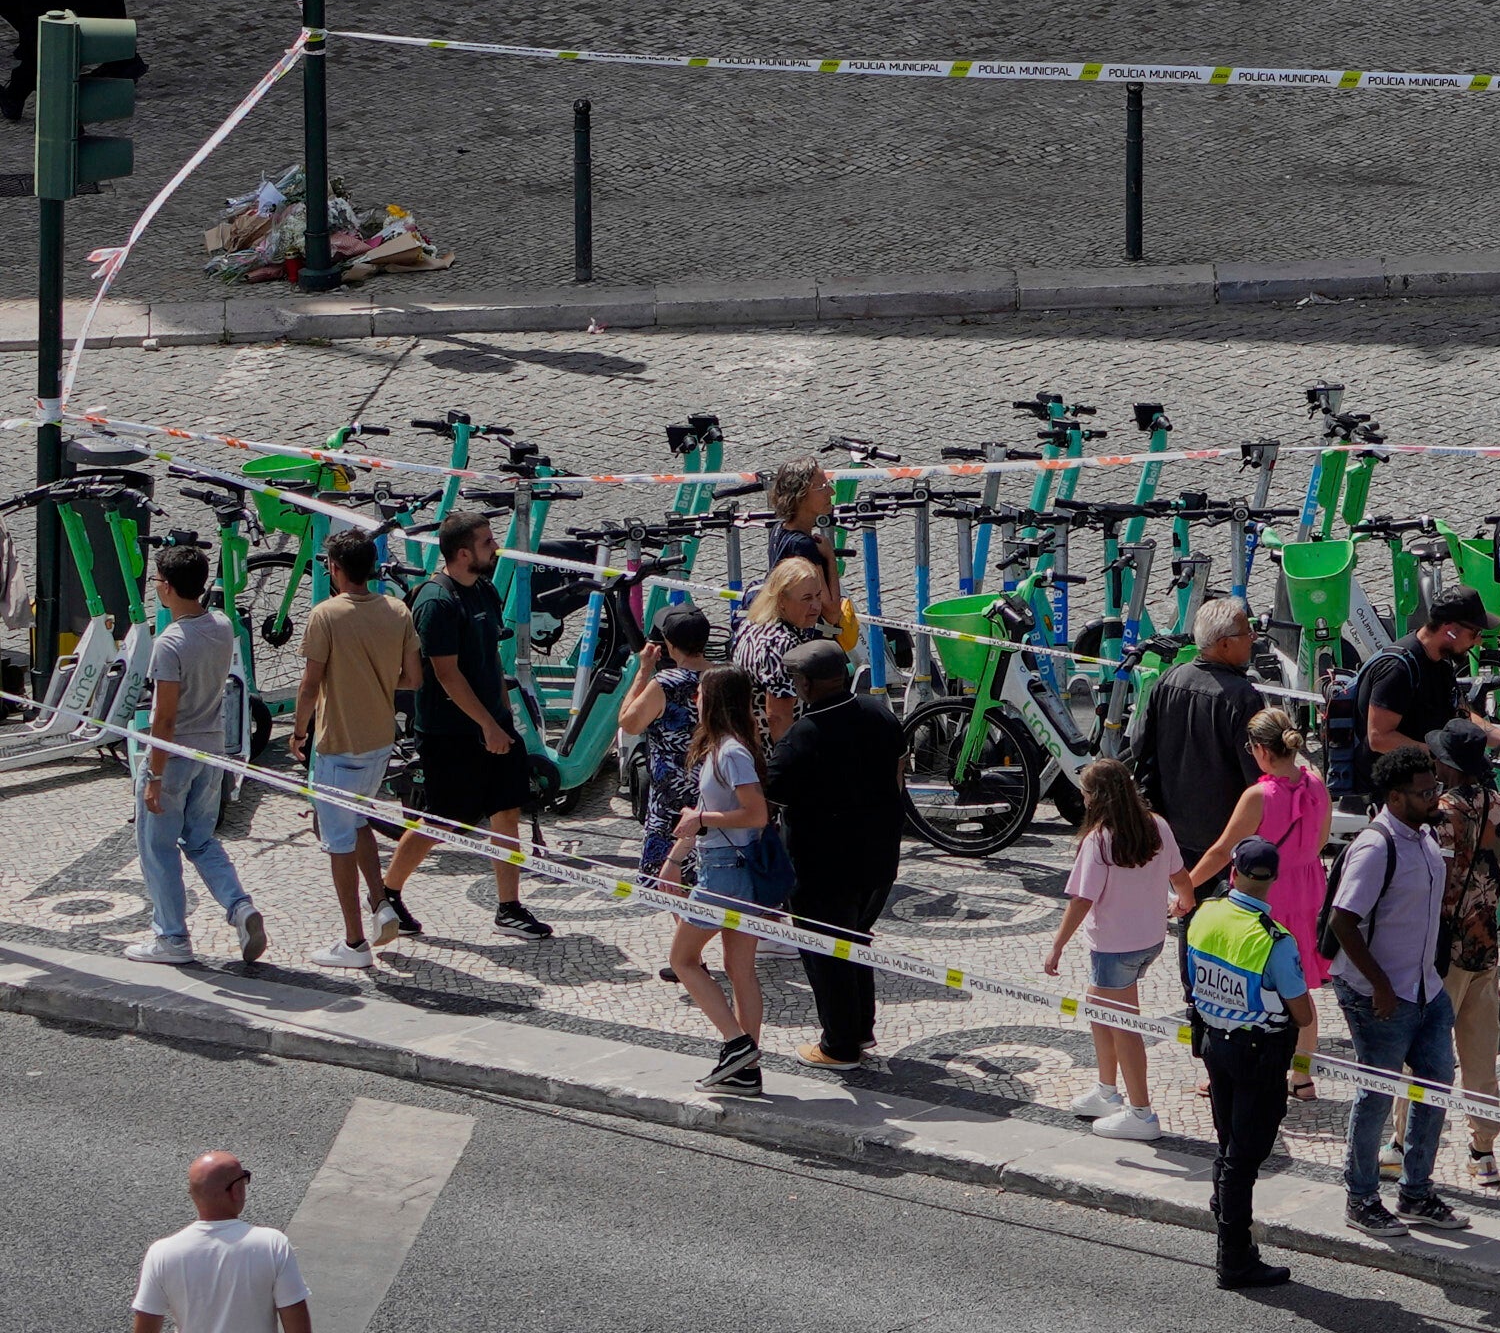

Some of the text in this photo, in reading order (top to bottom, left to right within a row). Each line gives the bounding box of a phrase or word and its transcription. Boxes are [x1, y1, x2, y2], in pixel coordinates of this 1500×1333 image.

[889, 64, 942, 73] MUNICIPAL
[1019, 67, 1072, 76] MUNICIPAL
[1109, 68, 1202, 80] POLÍCIA MUNICIPAL
[1239, 71, 1331, 83] POLÍCIA MUNICIPAL
[1368, 76, 1461, 87] POLÍCIA MUNICIPAL
[1053, 590, 1063, 634] BIRD
[68, 664, 98, 714] Lime
[1023, 700, 1061, 758] Lime
[672, 898, 718, 919] MUNICIPAL
[781, 927, 828, 949] MUNICIPAL
[892, 958, 938, 979] MUNICIPAL
[1196, 965, 1245, 999] OLÍCIA
[1005, 986, 1053, 1009] MUNICIPAL
[1121, 1015, 1170, 1036] MUNICIPAL
